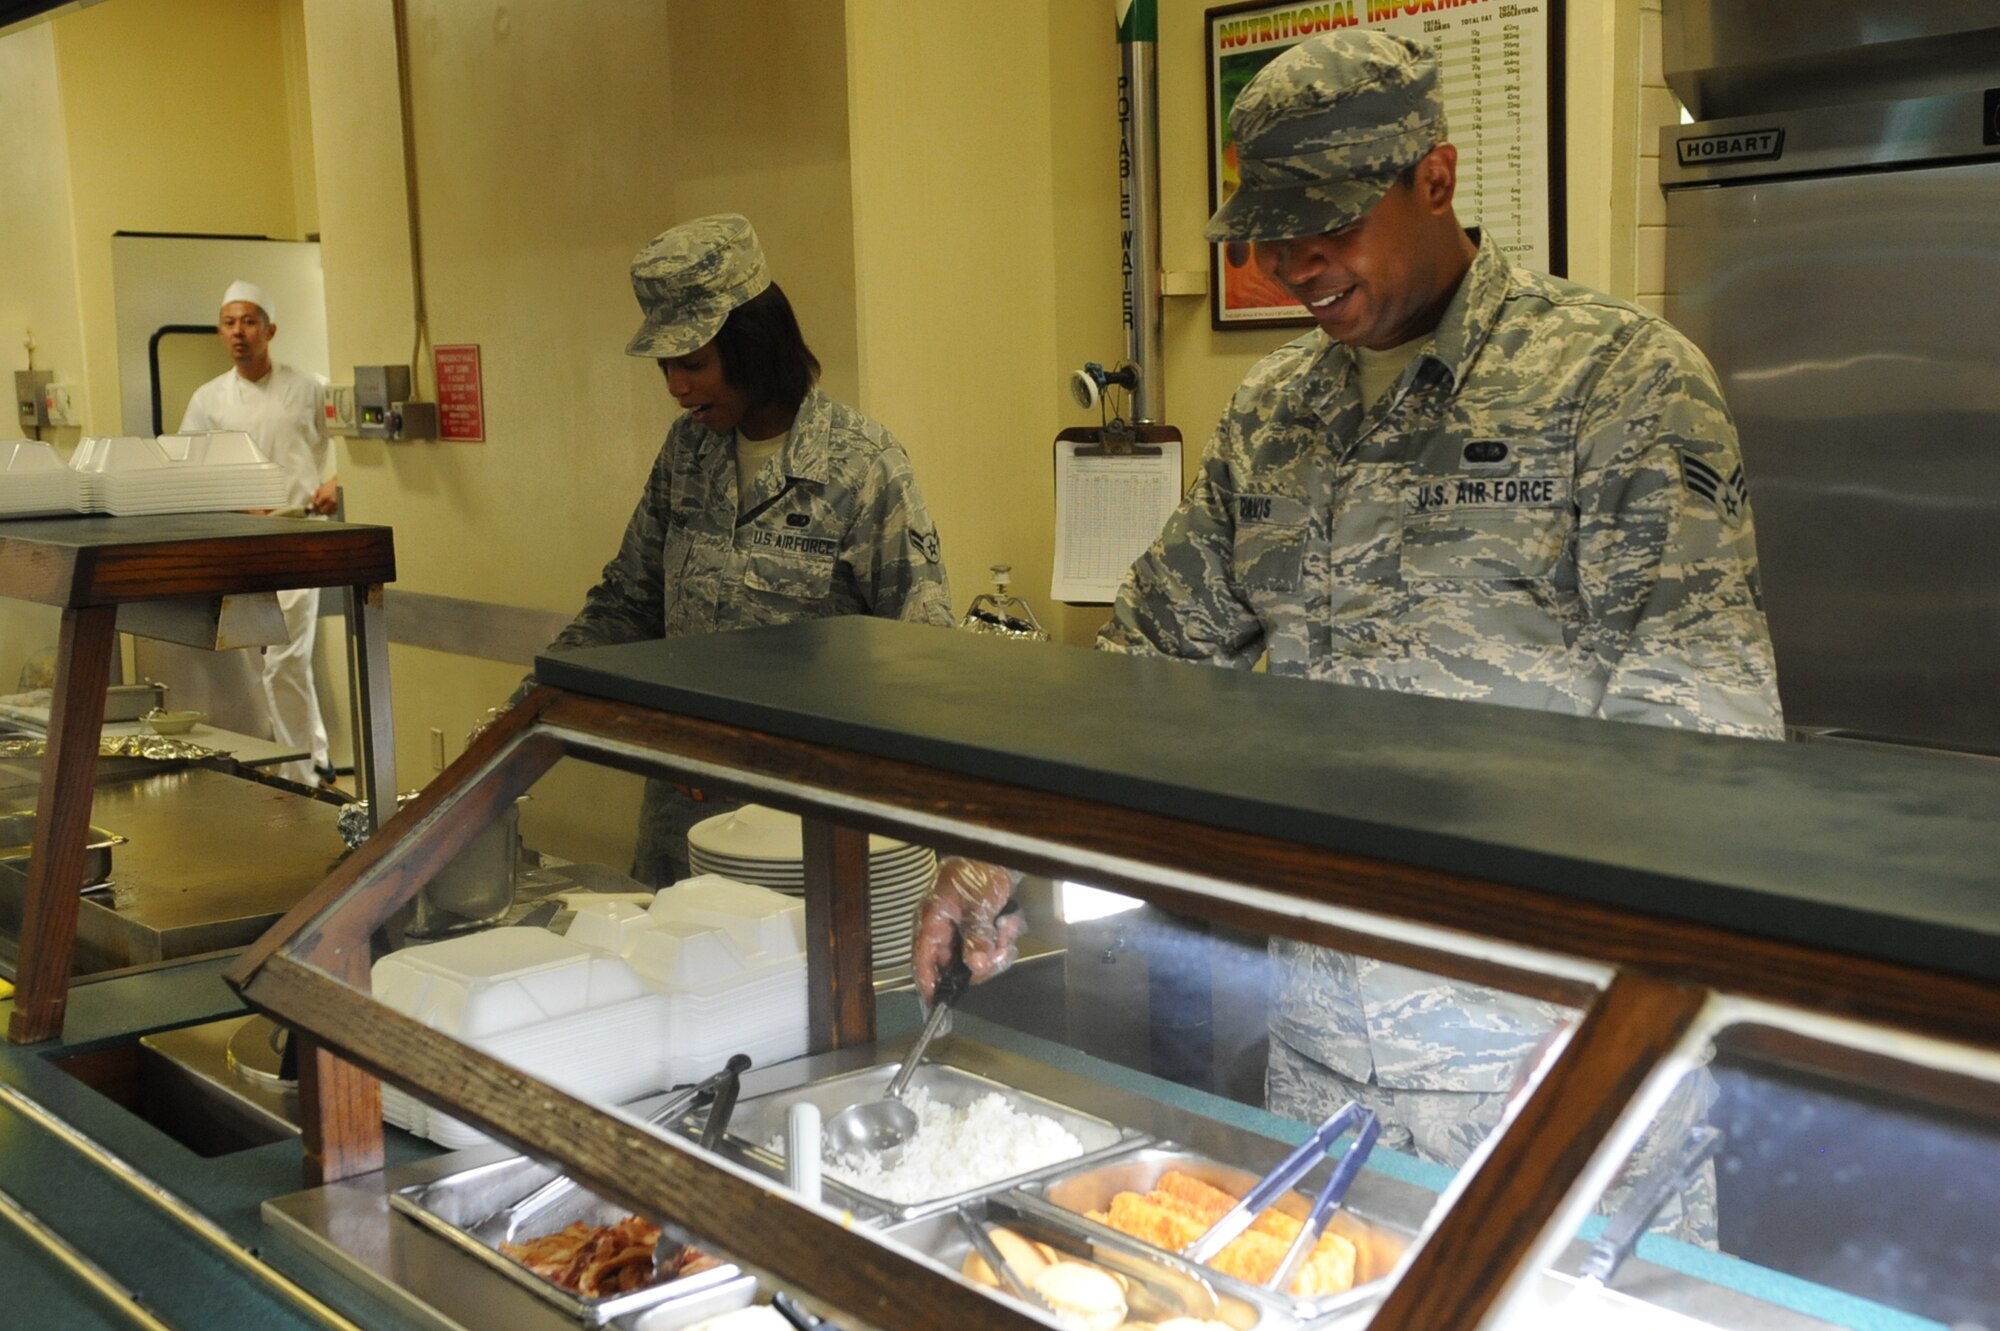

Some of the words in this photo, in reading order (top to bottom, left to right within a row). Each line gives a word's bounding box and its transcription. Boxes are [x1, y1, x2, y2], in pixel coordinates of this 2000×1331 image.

[1499, 4, 1518, 13] TOTAL
[1499, 6, 1539, 19] CHOLESTEROL
[1220, 0, 1359, 49] NUTRITIONAL
[1424, 19, 1441, 27] TOTAL
[1424, 23, 1451, 33] CALORIES
[1461, 17, 1480, 26] TOTAL
[1117, 76, 1130, 219] POTABLE
[1686, 135, 1772, 158] HOBART
[1120, 230, 1133, 330] WATER
[1419, 484, 1449, 508] U.S.
[1456, 481, 1486, 504] AIR
[1494, 480, 1554, 503] FORCE
[753, 530, 771, 546] U.S.
[775, 534, 793, 550] AIR
[794, 536, 834, 554] FORCE
